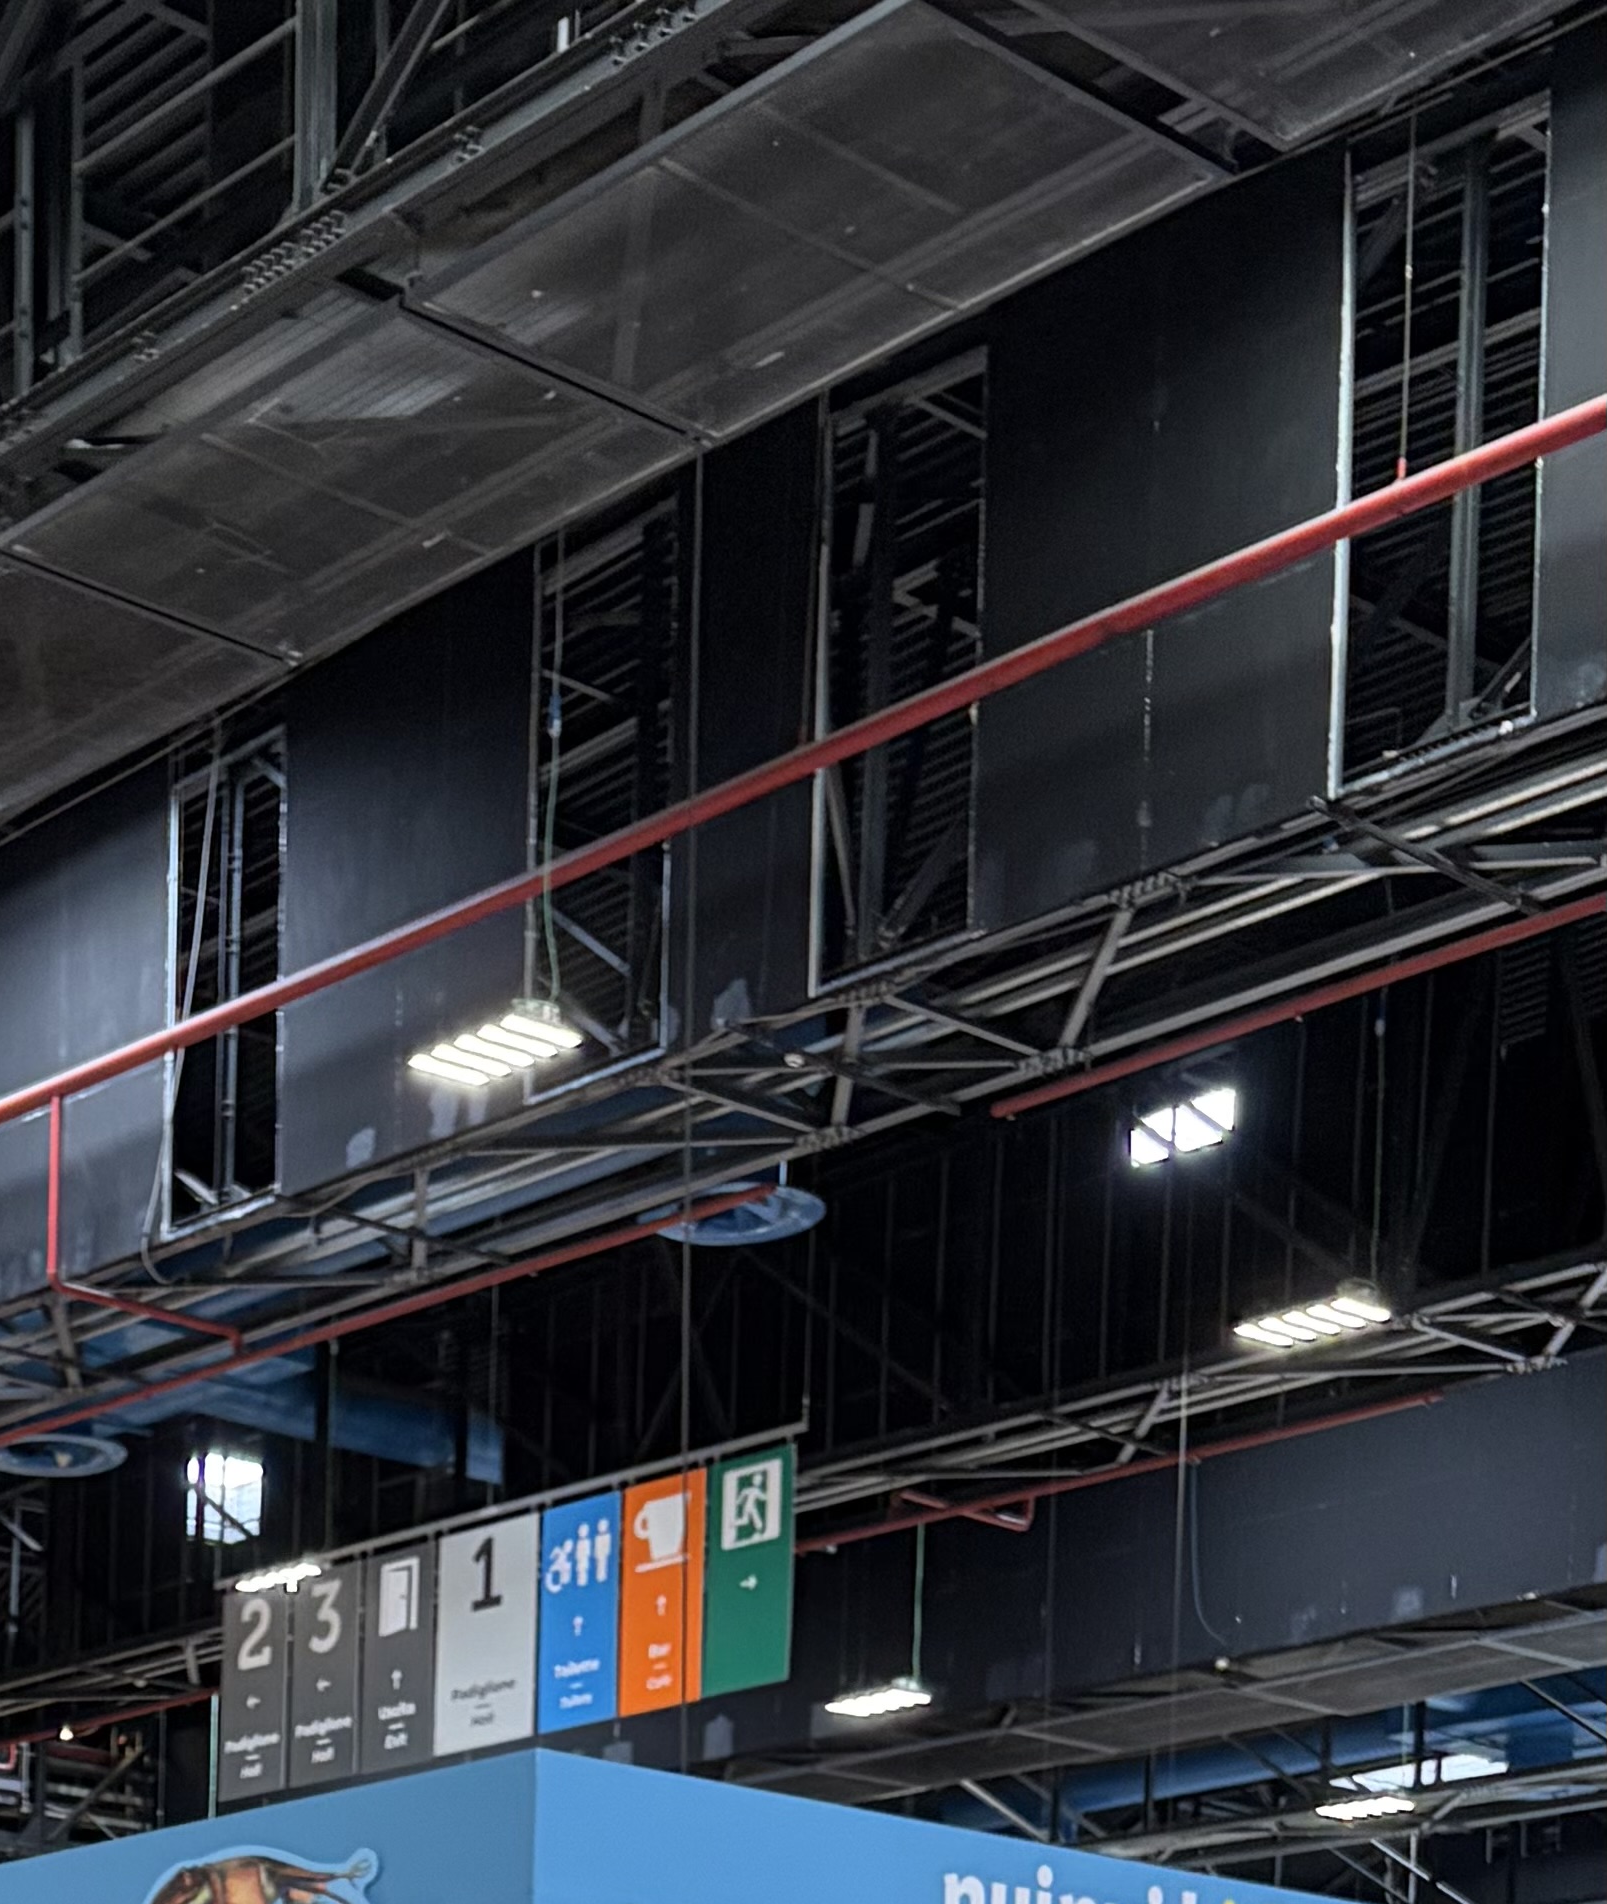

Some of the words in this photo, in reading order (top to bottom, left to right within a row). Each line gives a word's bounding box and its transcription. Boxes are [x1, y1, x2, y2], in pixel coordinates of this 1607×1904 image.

[471, 1538, 503, 1612] 1
[237, 1600, 272, 1670] 2
[308, 1579, 342, 1653] 3
